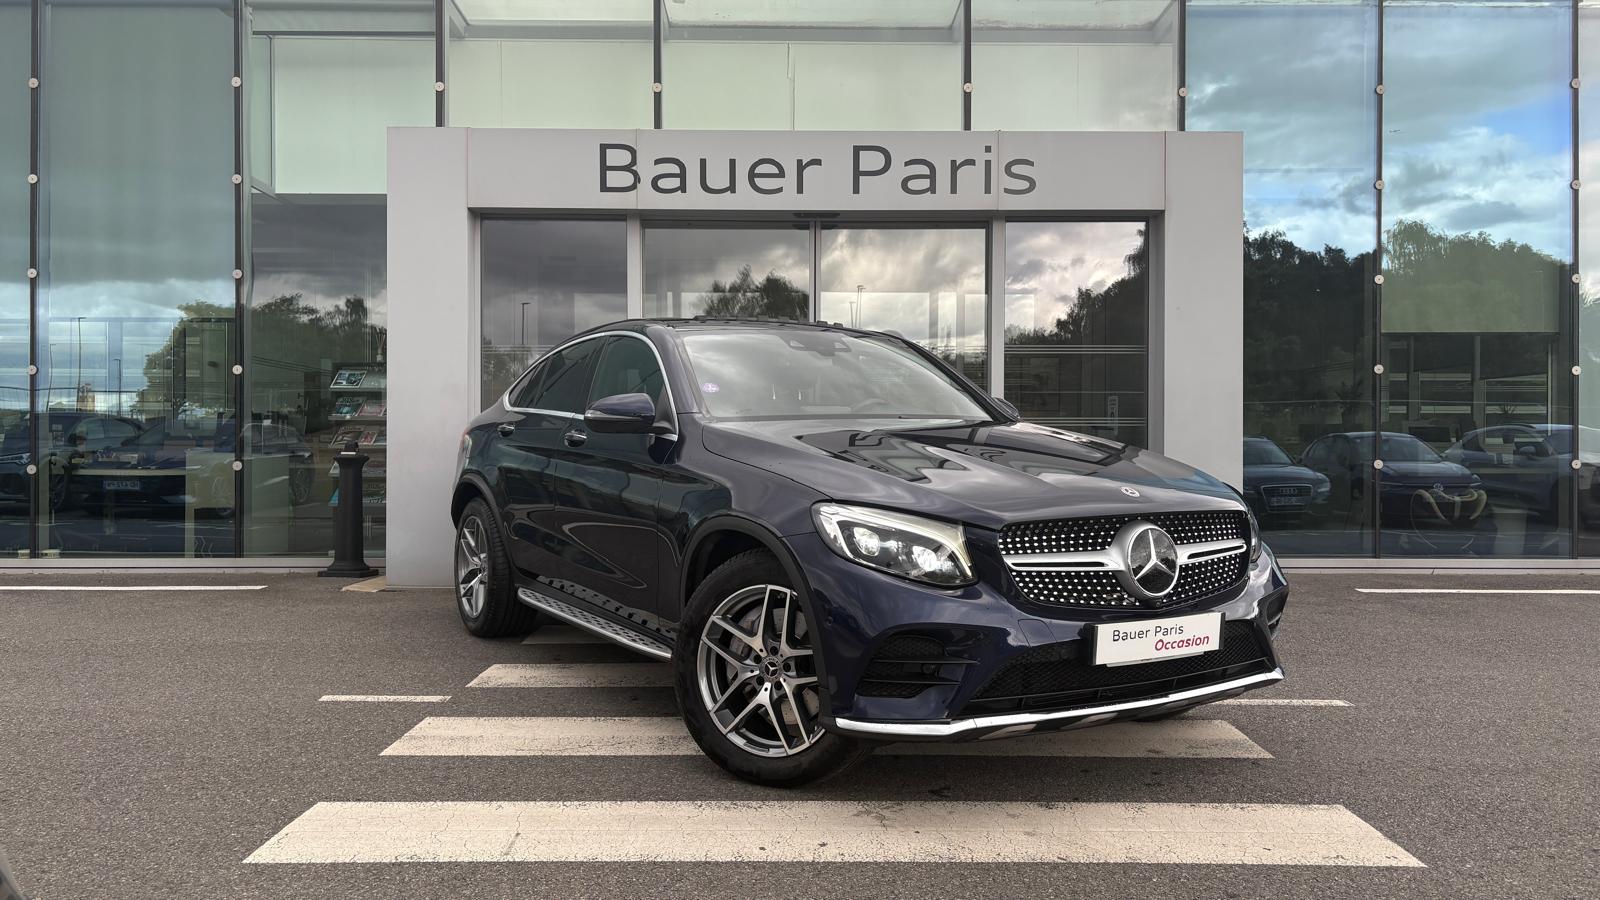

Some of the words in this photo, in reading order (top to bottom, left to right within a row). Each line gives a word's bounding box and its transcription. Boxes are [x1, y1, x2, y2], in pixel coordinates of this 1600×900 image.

[599, 143, 822, 195] Bauer
[852, 144, 1037, 196] Paris
[1112, 628, 1151, 642] Bauer
[1154, 624, 1184, 637] Paris
[1154, 635, 1210, 652] Occasion
